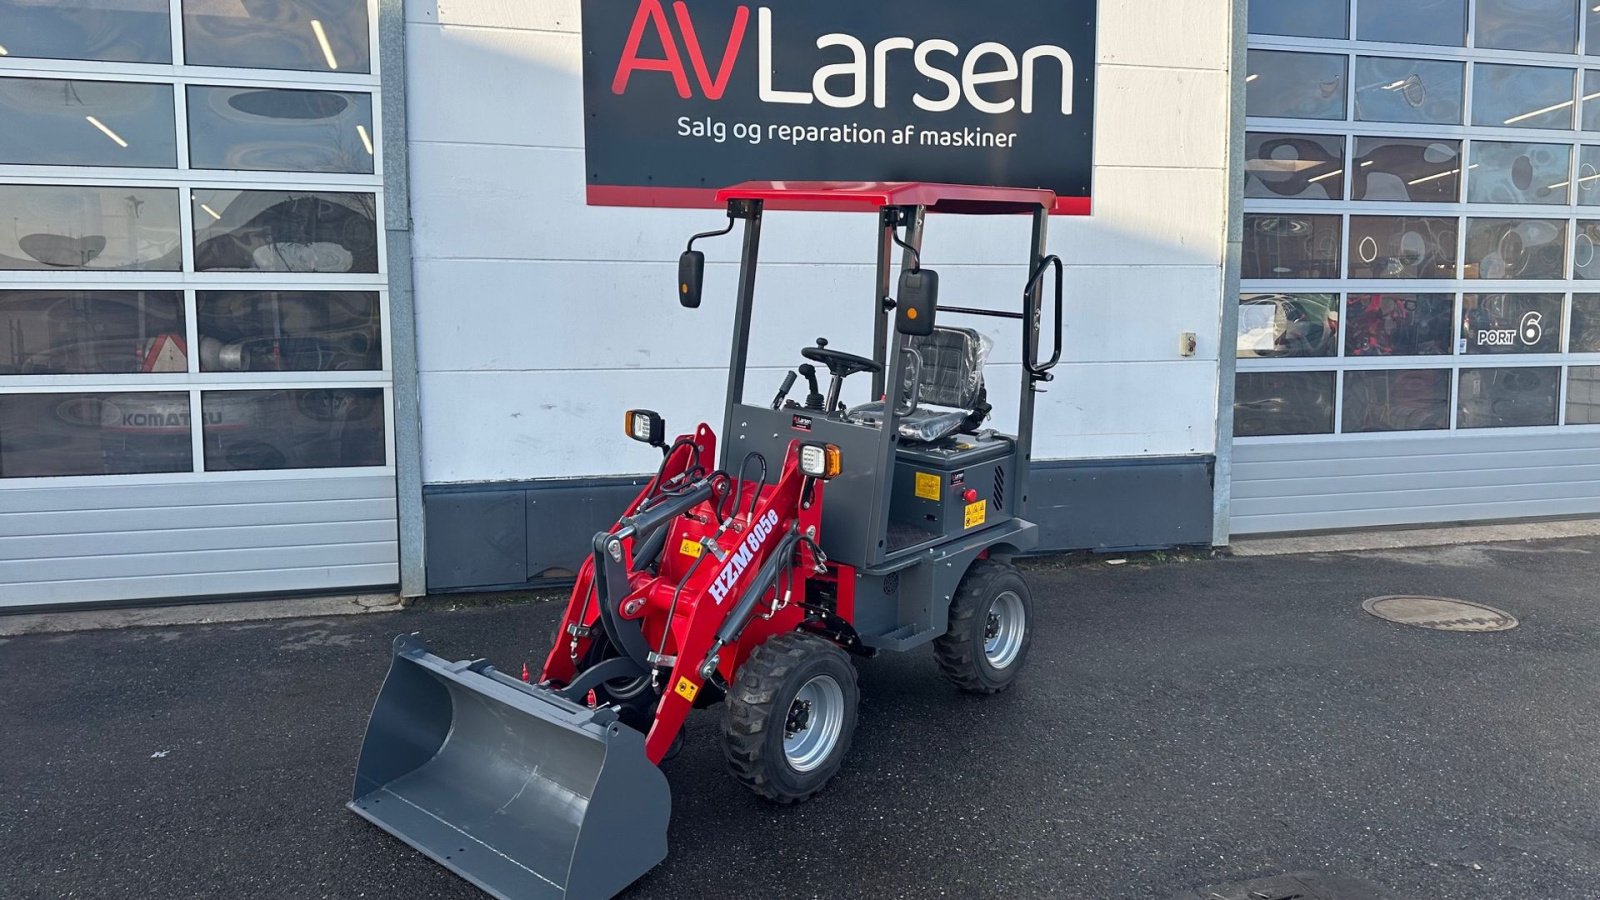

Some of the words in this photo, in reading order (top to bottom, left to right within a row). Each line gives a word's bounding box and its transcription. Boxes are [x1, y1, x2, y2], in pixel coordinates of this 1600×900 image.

[677, 116, 727, 143] Salg
[733, 123, 761, 144] og
[768, 122, 886, 146] reparation
[891, 124, 915, 145] af
[920, 127, 1017, 148] maskiner
[1477, 329, 1517, 346] PORT
[1519, 310, 1543, 346] 6
